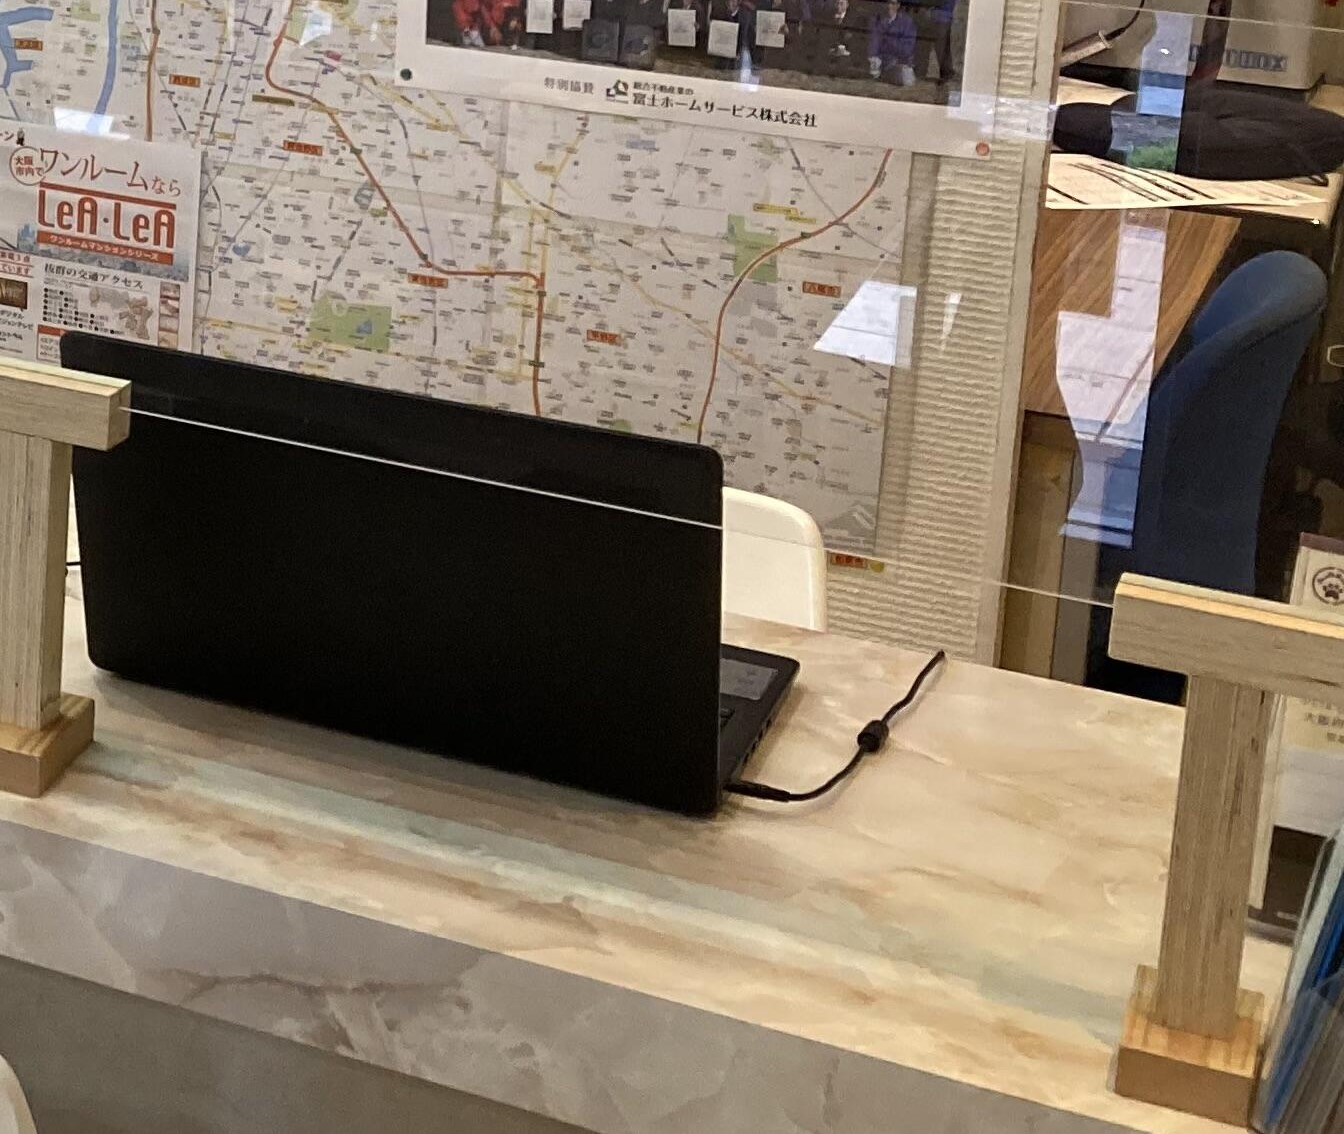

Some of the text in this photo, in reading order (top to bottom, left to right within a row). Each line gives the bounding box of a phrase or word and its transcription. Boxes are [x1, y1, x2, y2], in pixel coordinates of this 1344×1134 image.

[632, 92, 818, 128] 富士ホームサービス株式会社
